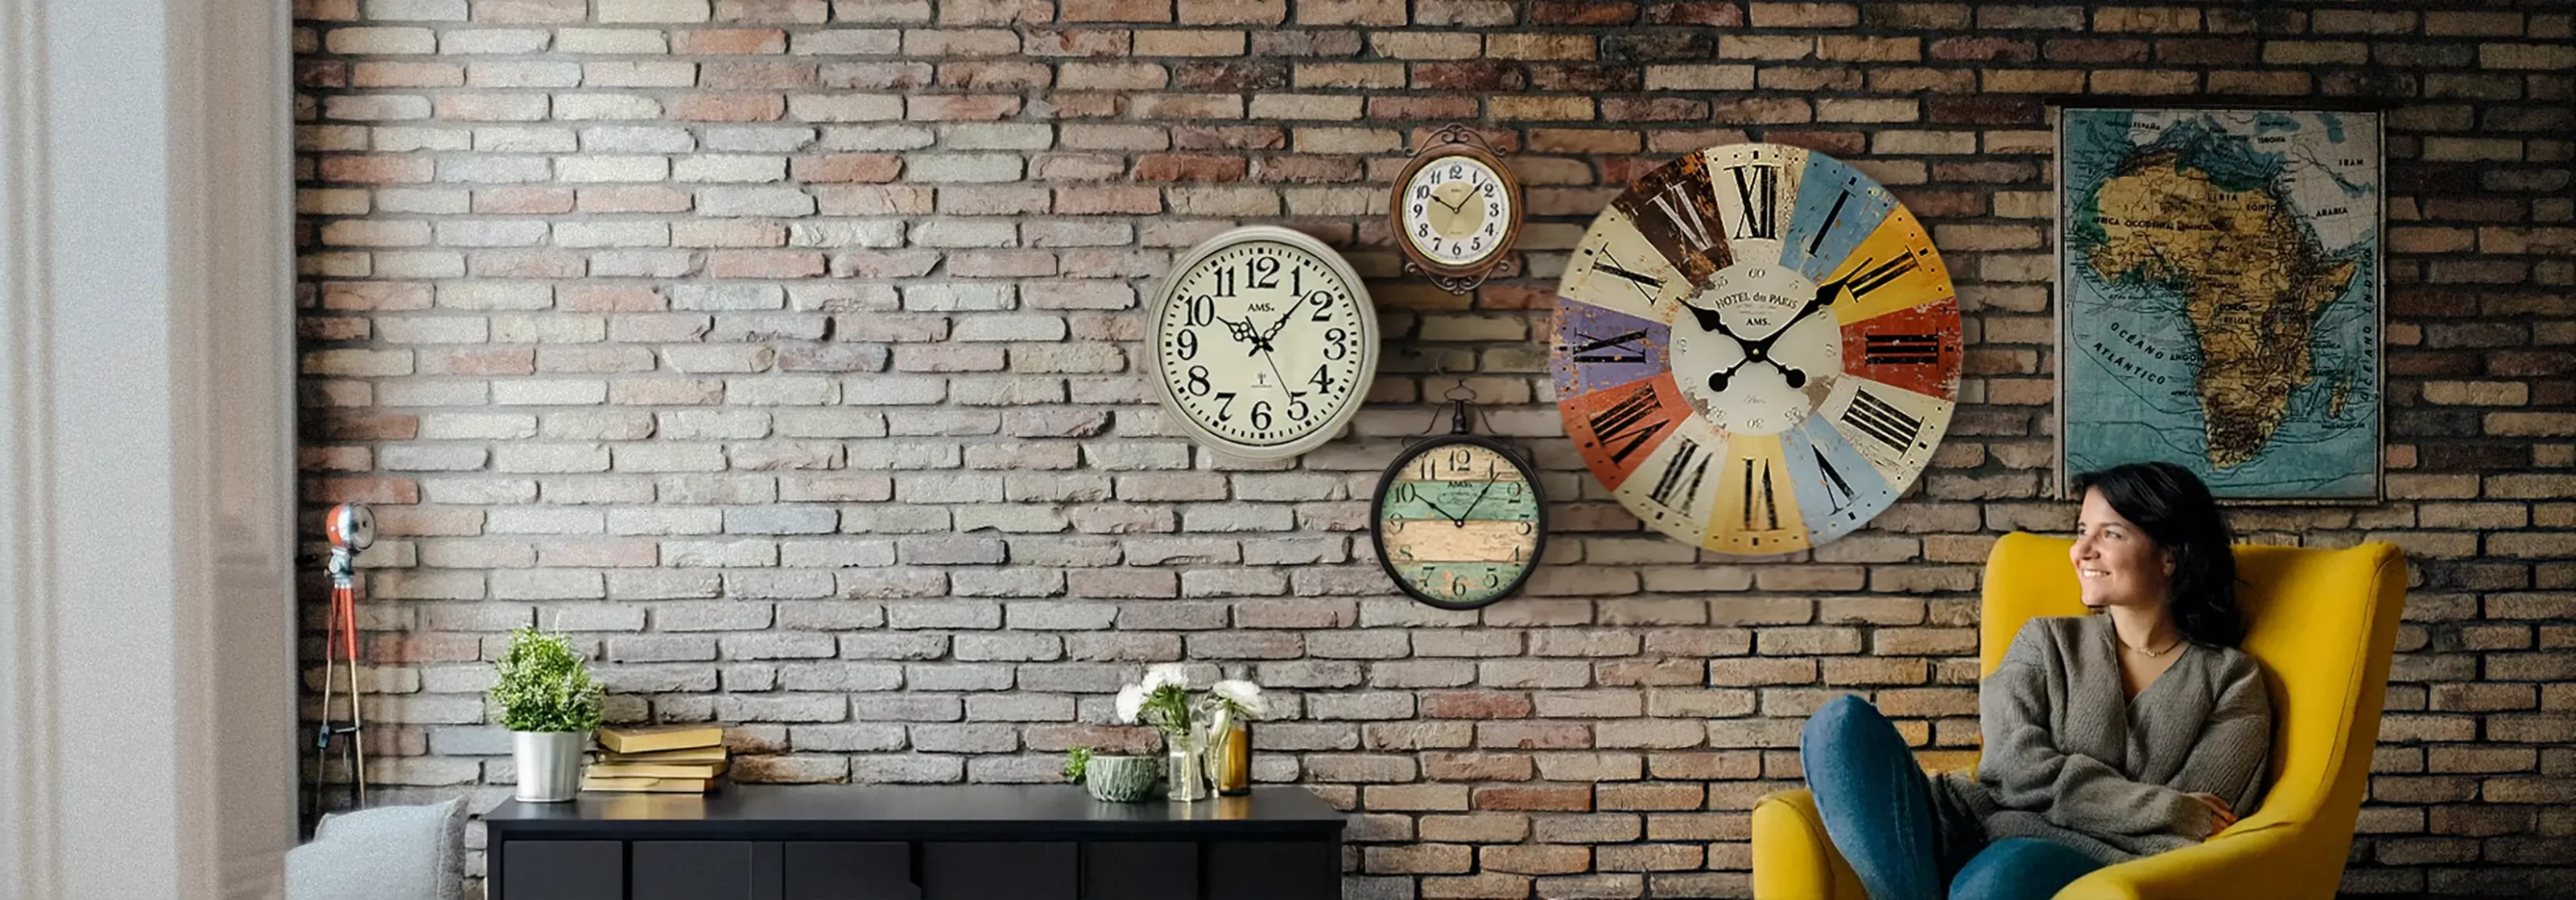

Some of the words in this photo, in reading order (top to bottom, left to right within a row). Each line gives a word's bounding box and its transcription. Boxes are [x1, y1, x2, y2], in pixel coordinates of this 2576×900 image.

[2133, 120, 2161, 130] ESPAÑA
[1430, 171, 1441, 184] 11
[1449, 165, 1462, 180] 12
[1472, 171, 1477, 184] 1
[1417, 185, 1430, 199] 10
[1484, 184, 1494, 197] 2
[1414, 204, 1422, 218] 9
[1490, 203, 1499, 217] 3
[1723, 165, 1781, 240] XII
[2316, 207, 2348, 217] ARABIA
[1418, 224, 1428, 237] 8
[1484, 222, 1494, 236] 4
[1646, 180, 1716, 263] XI
[1807, 185, 1856, 258] I
[1433, 237, 1442, 251] 7
[1452, 242, 1461, 255] 6
[1472, 237, 1480, 250] 5
[1213, 266, 1236, 297] 11
[1246, 257, 1280, 289] 12
[1290, 266, 1302, 296] 1
[1591, 242, 1667, 306] X
[1846, 246, 1922, 303] II
[1184, 295, 1214, 327] 10
[1310, 291, 1333, 321] 2
[1715, 292, 1751, 308] HOTEL
[1752, 293, 1766, 302] du
[1769, 294, 1798, 309] PARIS
[1177, 329, 1197, 360] 9
[1323, 328, 1346, 360] 3
[1574, 328, 1648, 364] IX
[1864, 332, 1939, 369] III
[2111, 322, 2164, 360] OCÉANO
[2094, 342, 2165, 385] ATLÁNTICO
[1188, 365, 1210, 395] 8
[1308, 365, 1334, 394] 4
[1214, 393, 1236, 422] 7
[1251, 401, 1272, 430] 6
[1287, 391, 1309, 420] 5
[1841, 386, 1925, 459] IIII
[1421, 458, 1435, 480] 11
[1449, 449, 1471, 471] 12
[1490, 459, 1494, 479] 1
[1811, 444, 1860, 516] V
[1394, 482, 1415, 503] 10
[1508, 482, 1521, 503] 2
[1741, 457, 1786, 532] VI
[1389, 513, 1404, 535] 9
[1516, 514, 1531, 535] 3
[1419, 567, 1436, 587] 7
[1452, 576, 1468, 596] 6
[1484, 568, 1498, 588] 5
